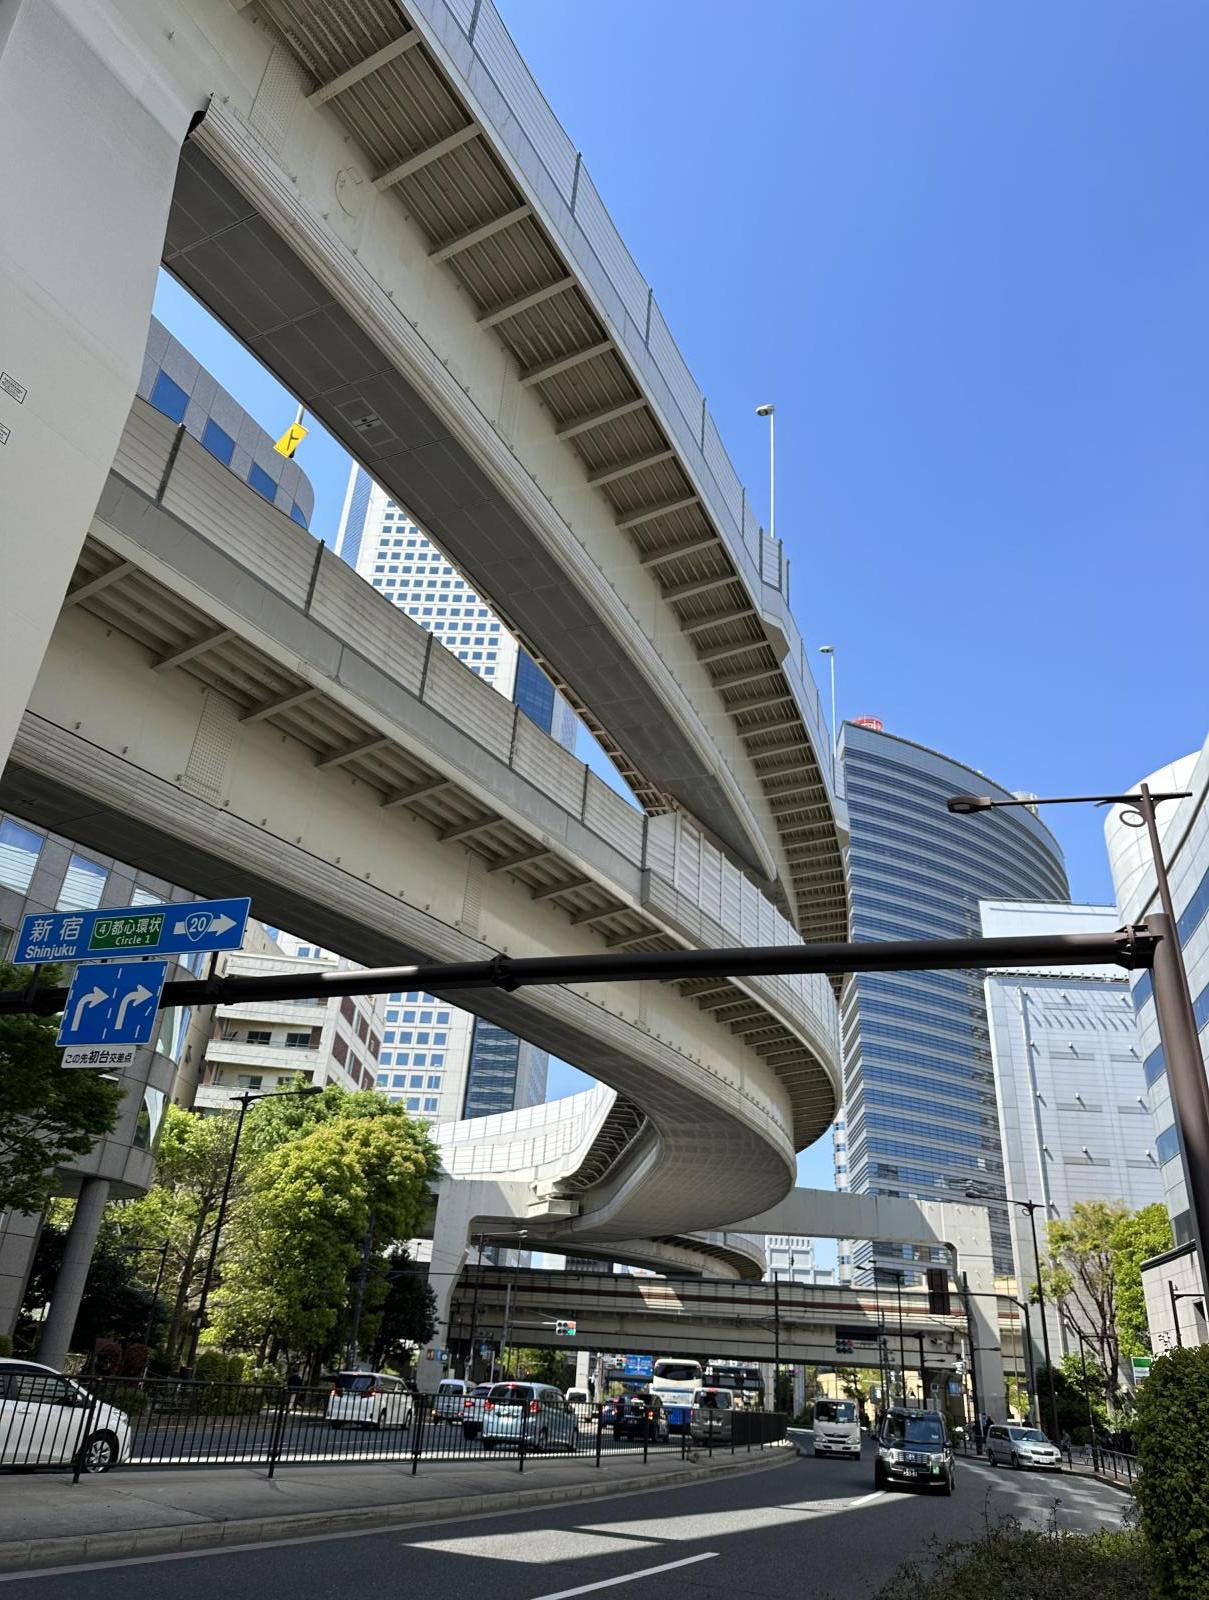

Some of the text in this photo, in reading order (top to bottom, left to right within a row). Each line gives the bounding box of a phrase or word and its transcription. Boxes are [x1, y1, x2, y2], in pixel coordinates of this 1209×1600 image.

[29, 916, 84, 942] 新宿
[98, 917, 163, 935] 4 都心環状
[189, 917, 207, 932] 20
[115, 935, 151, 946] Circle 1
[25, 944, 76, 960] Shinjuku
[65, 1050, 133, 1064] この先初台交差点
